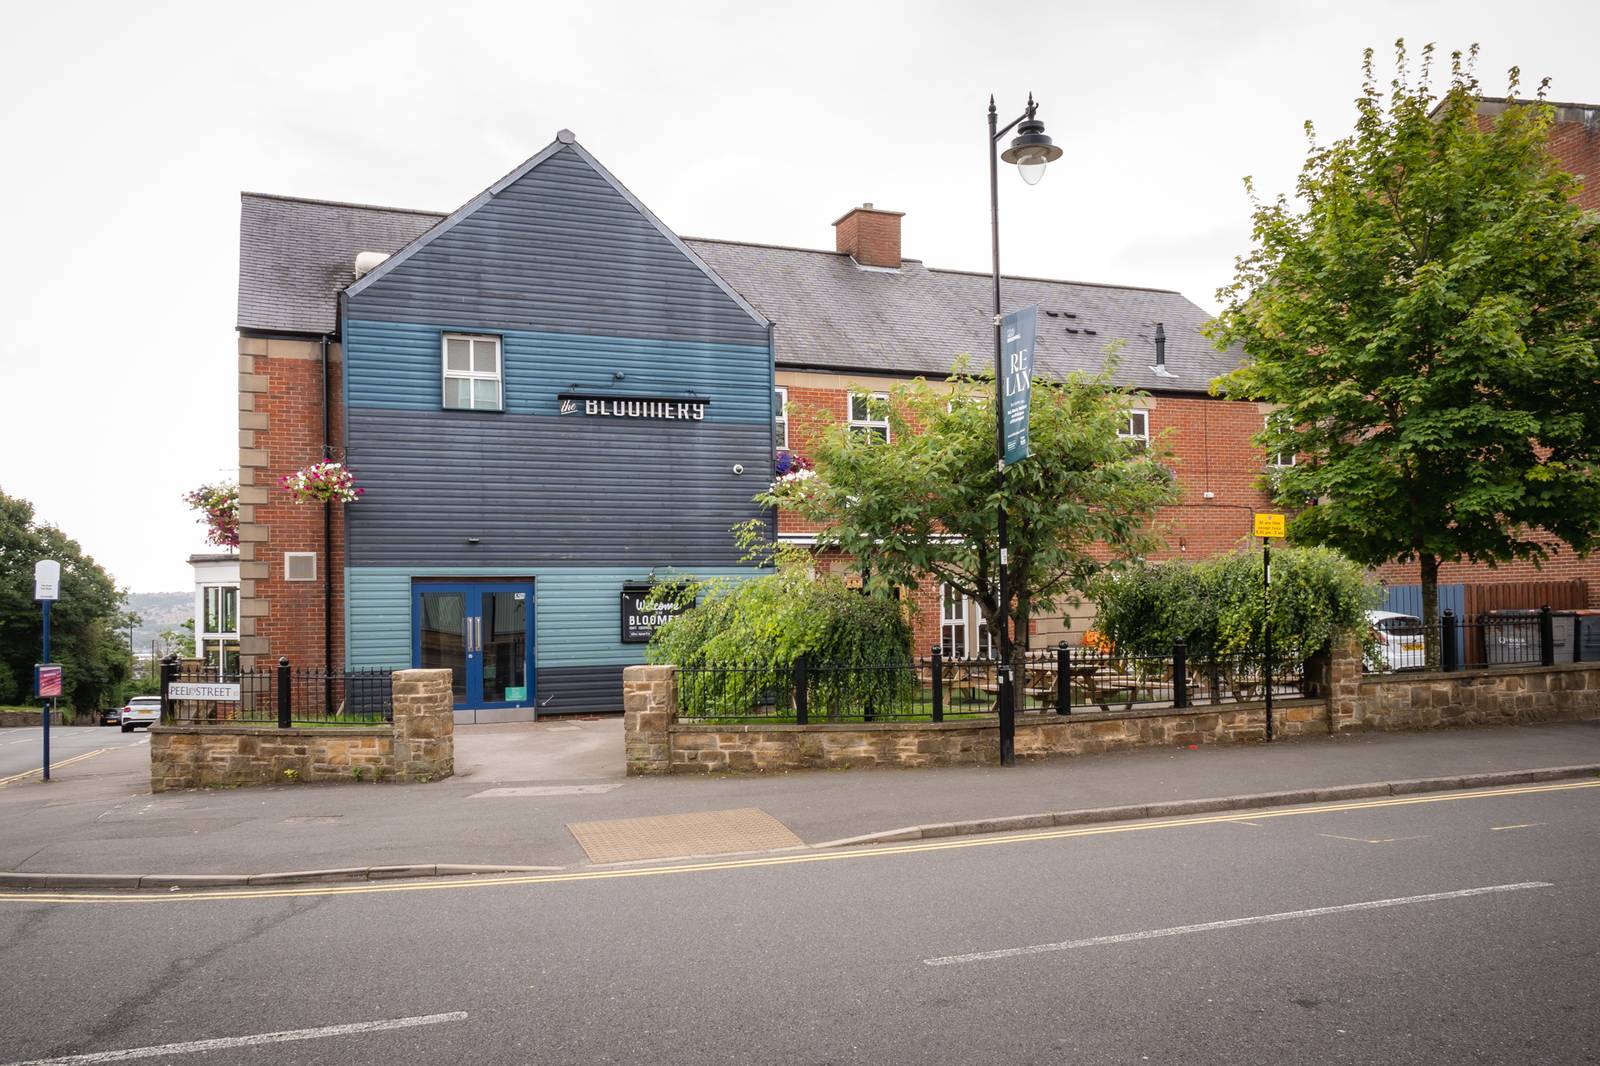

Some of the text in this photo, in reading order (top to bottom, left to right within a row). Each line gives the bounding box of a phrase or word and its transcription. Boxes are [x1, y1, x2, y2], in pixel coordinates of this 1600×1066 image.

[1010, 349, 1028, 374] RE
[560, 400, 704, 420] the BLOOMERS
[170, 686, 191, 696] PEEL
[195, 686, 232, 697] STREET
